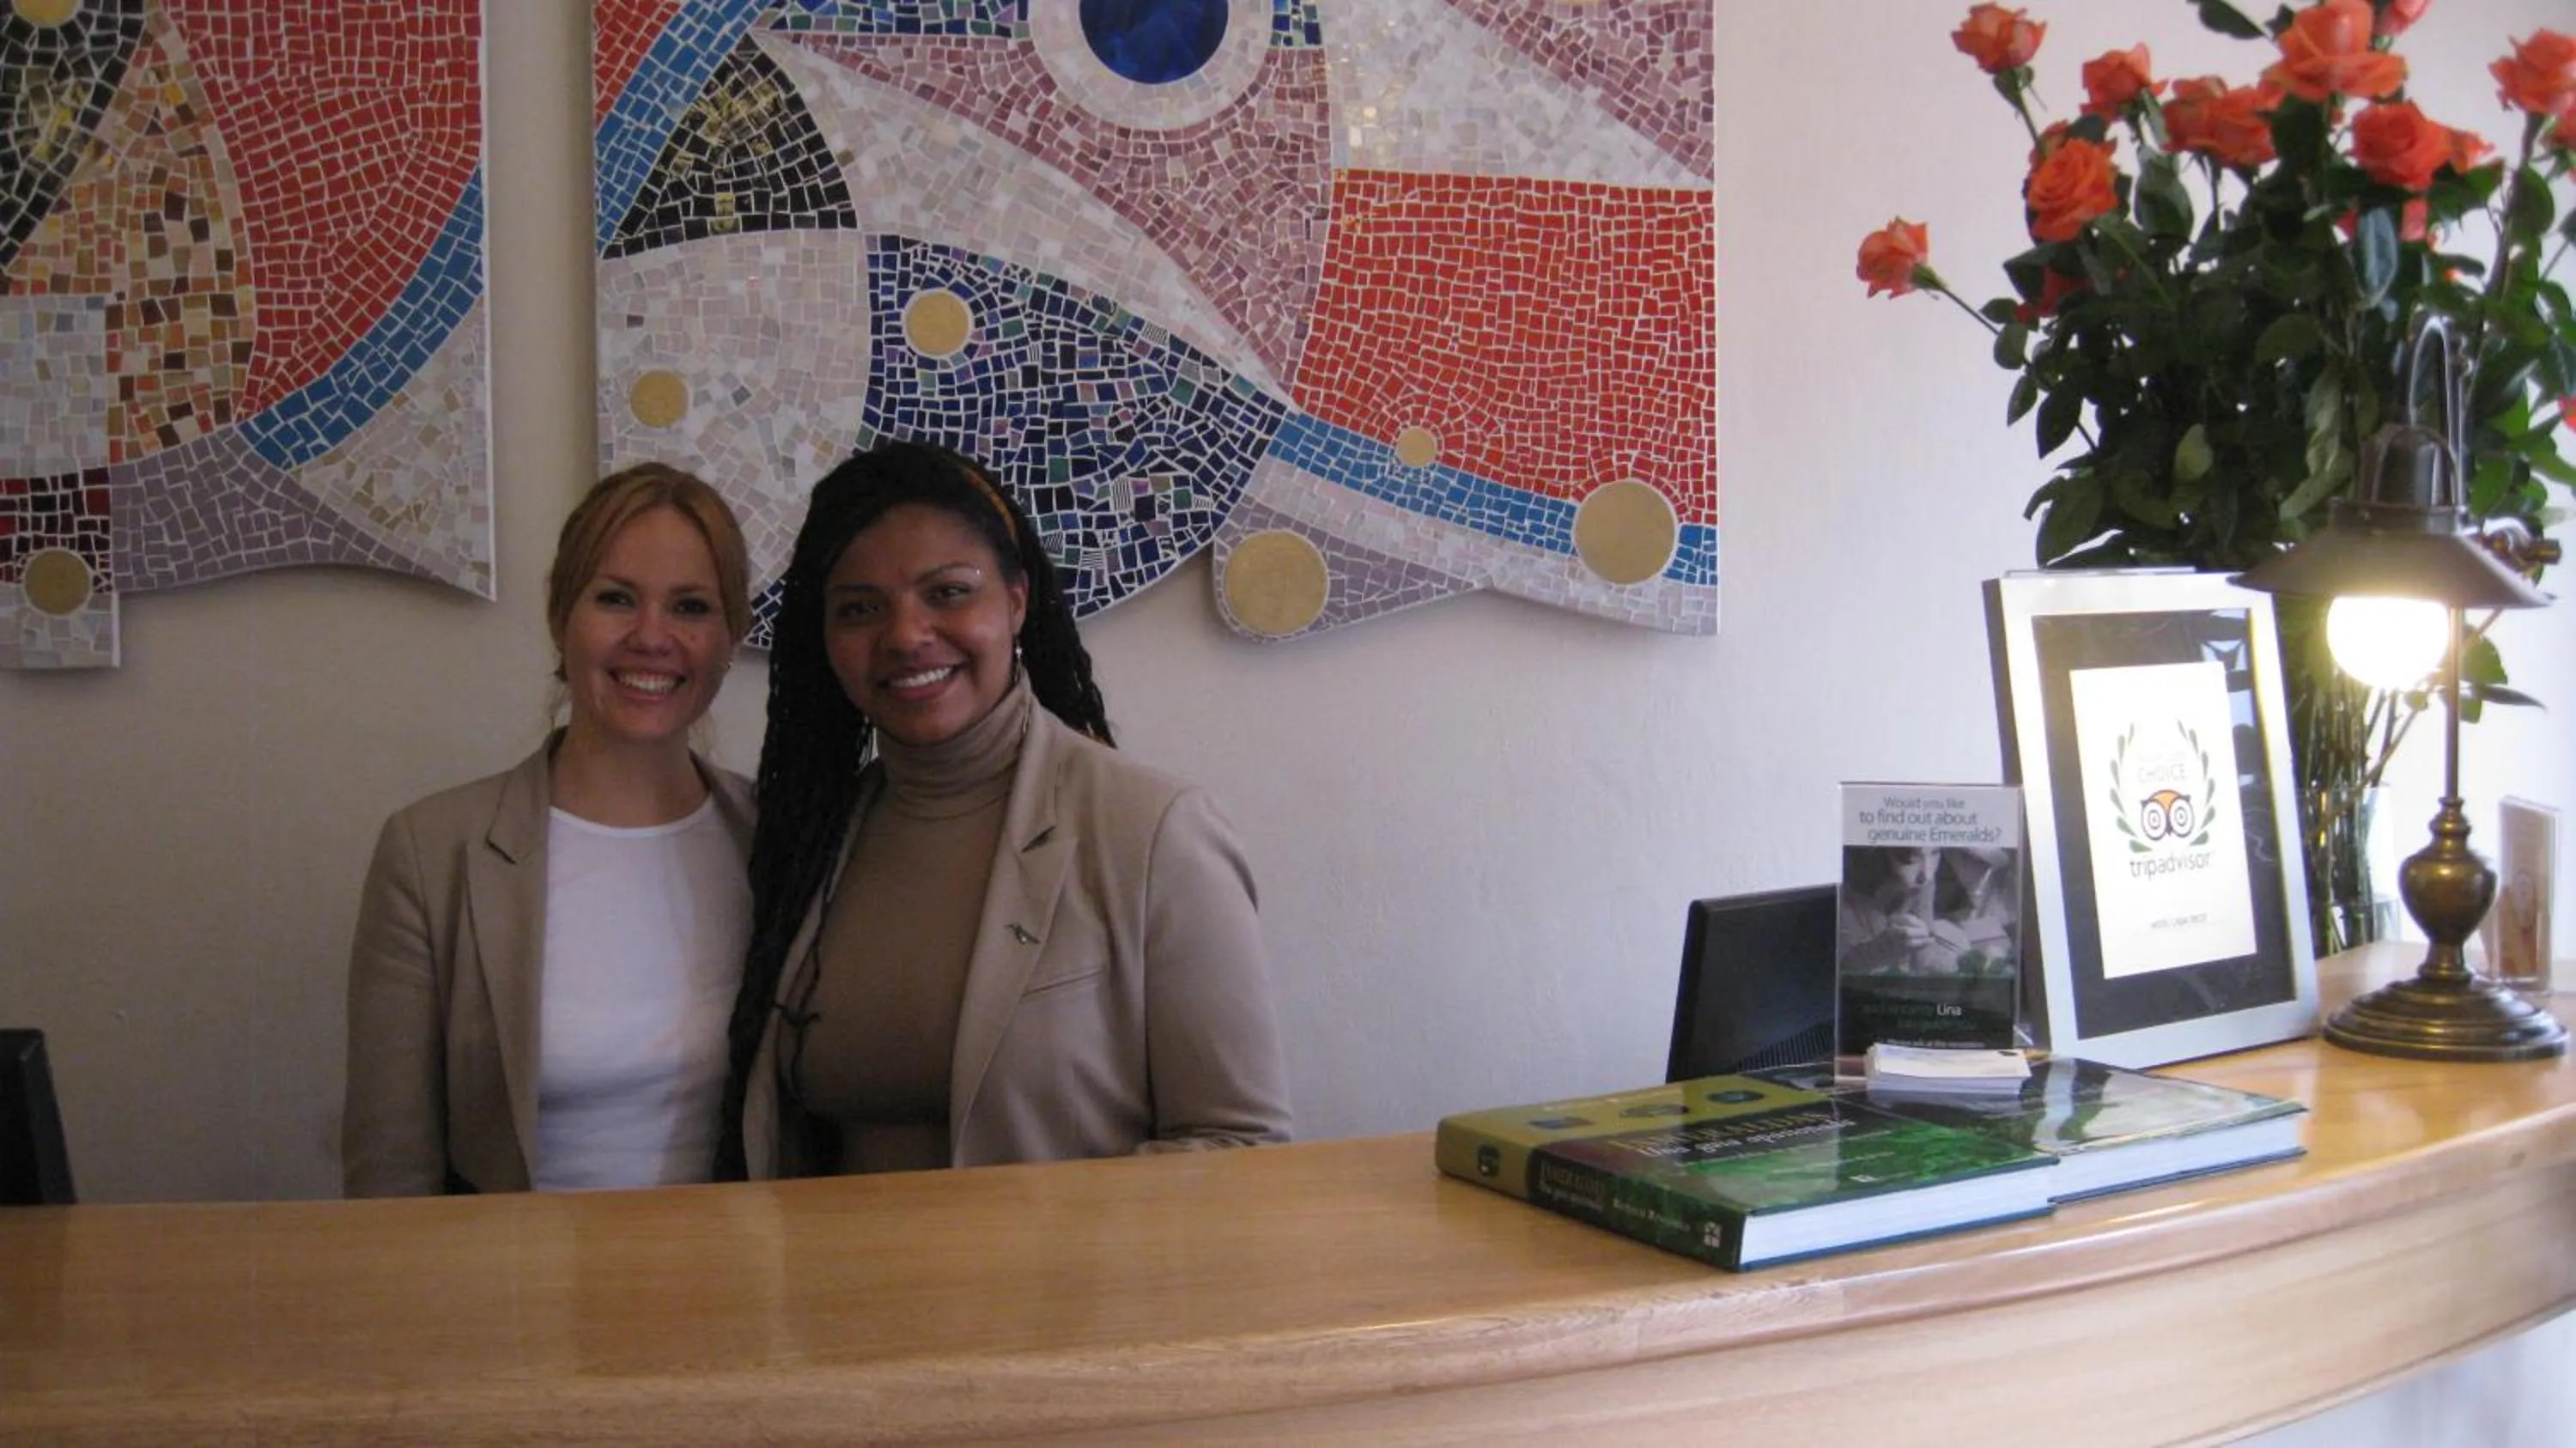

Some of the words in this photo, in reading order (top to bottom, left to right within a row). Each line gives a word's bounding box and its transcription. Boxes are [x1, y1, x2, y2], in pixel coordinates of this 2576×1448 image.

[1883, 796, 1921, 809] Would
[1923, 799, 1944, 811] you
[1946, 797, 1965, 809] like
[1860, 811, 1874, 824] to
[1878, 809, 1905, 824] find
[1907, 812, 1931, 824] out
[1935, 810, 1978, 824] about
[1868, 827, 1927, 843] genuine
[1929, 827, 2002, 843] Emeralds?
[2129, 852, 2212, 880] tripadvisor
[1936, 1002, 1962, 1016] Lina
